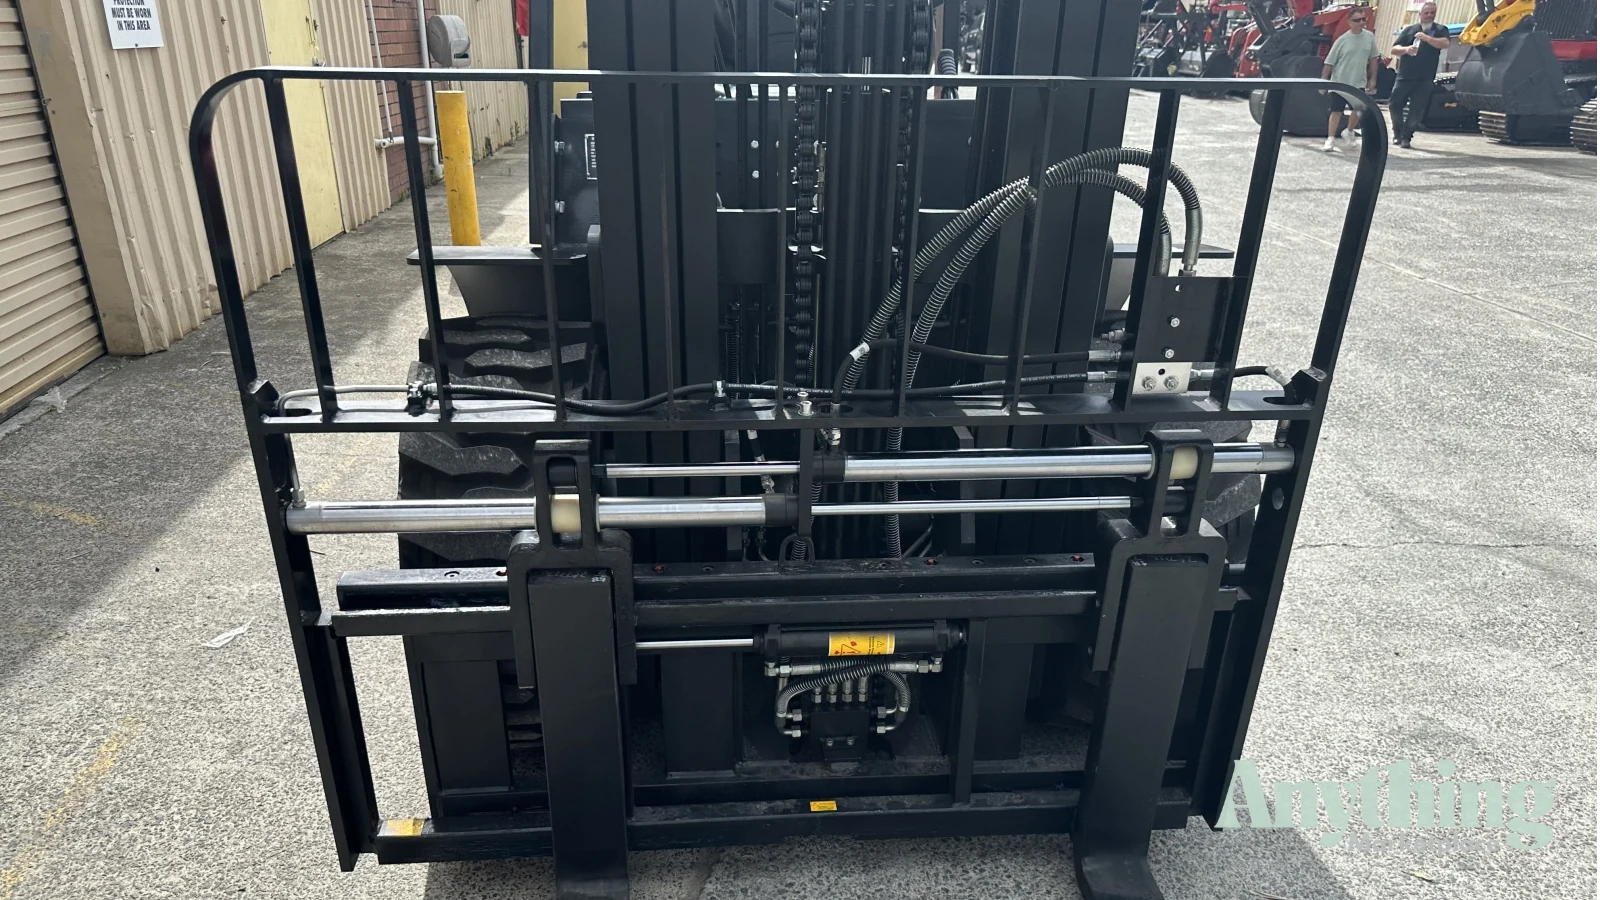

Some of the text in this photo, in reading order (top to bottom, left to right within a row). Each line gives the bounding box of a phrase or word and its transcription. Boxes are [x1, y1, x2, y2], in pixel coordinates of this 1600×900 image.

[111, 7, 151, 18] MUST BE WORN
[116, 20, 151, 30] IN THIS AREA
